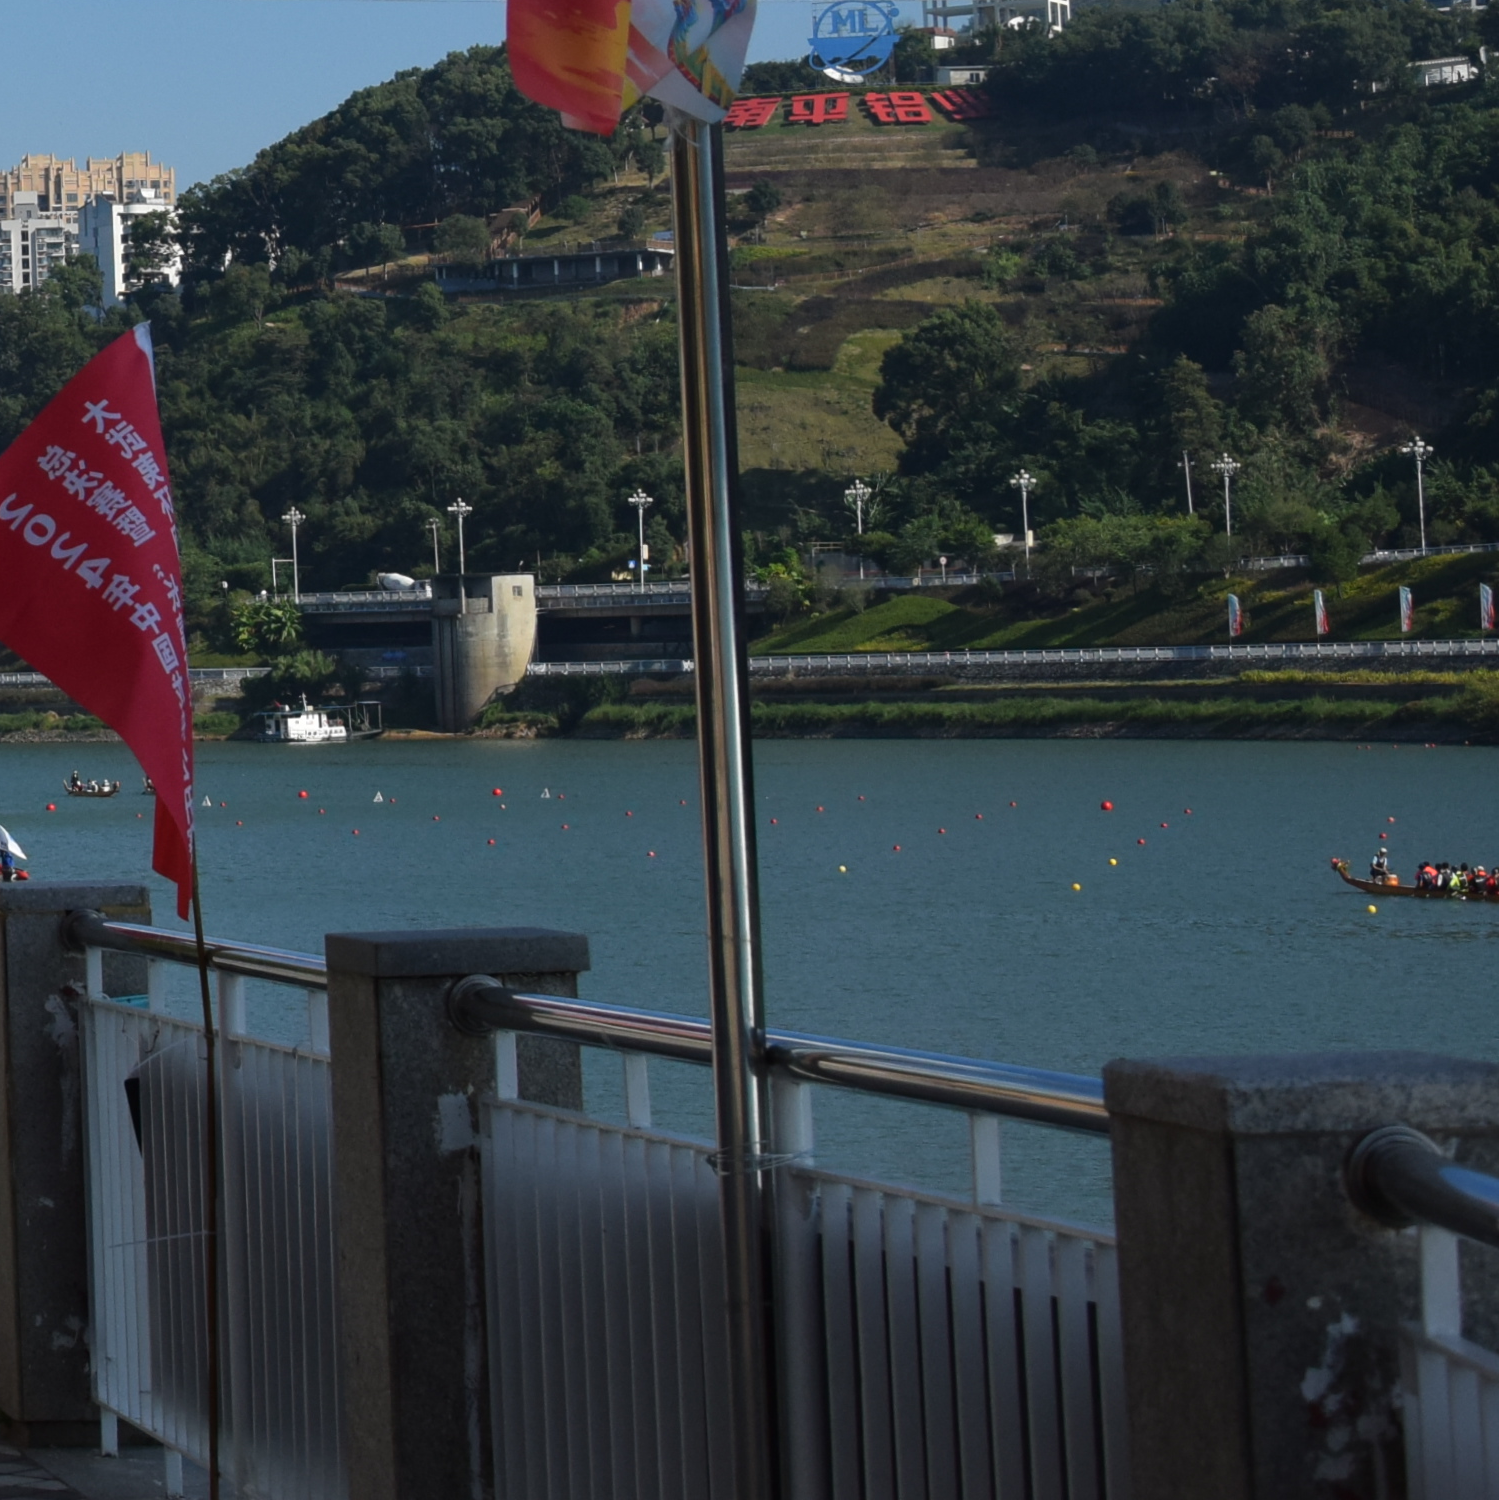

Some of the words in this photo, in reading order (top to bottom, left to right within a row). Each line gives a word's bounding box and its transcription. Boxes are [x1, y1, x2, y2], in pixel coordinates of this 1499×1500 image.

[830, 9, 879, 35] ML
[723, 91, 995, 127] 南平铝业
